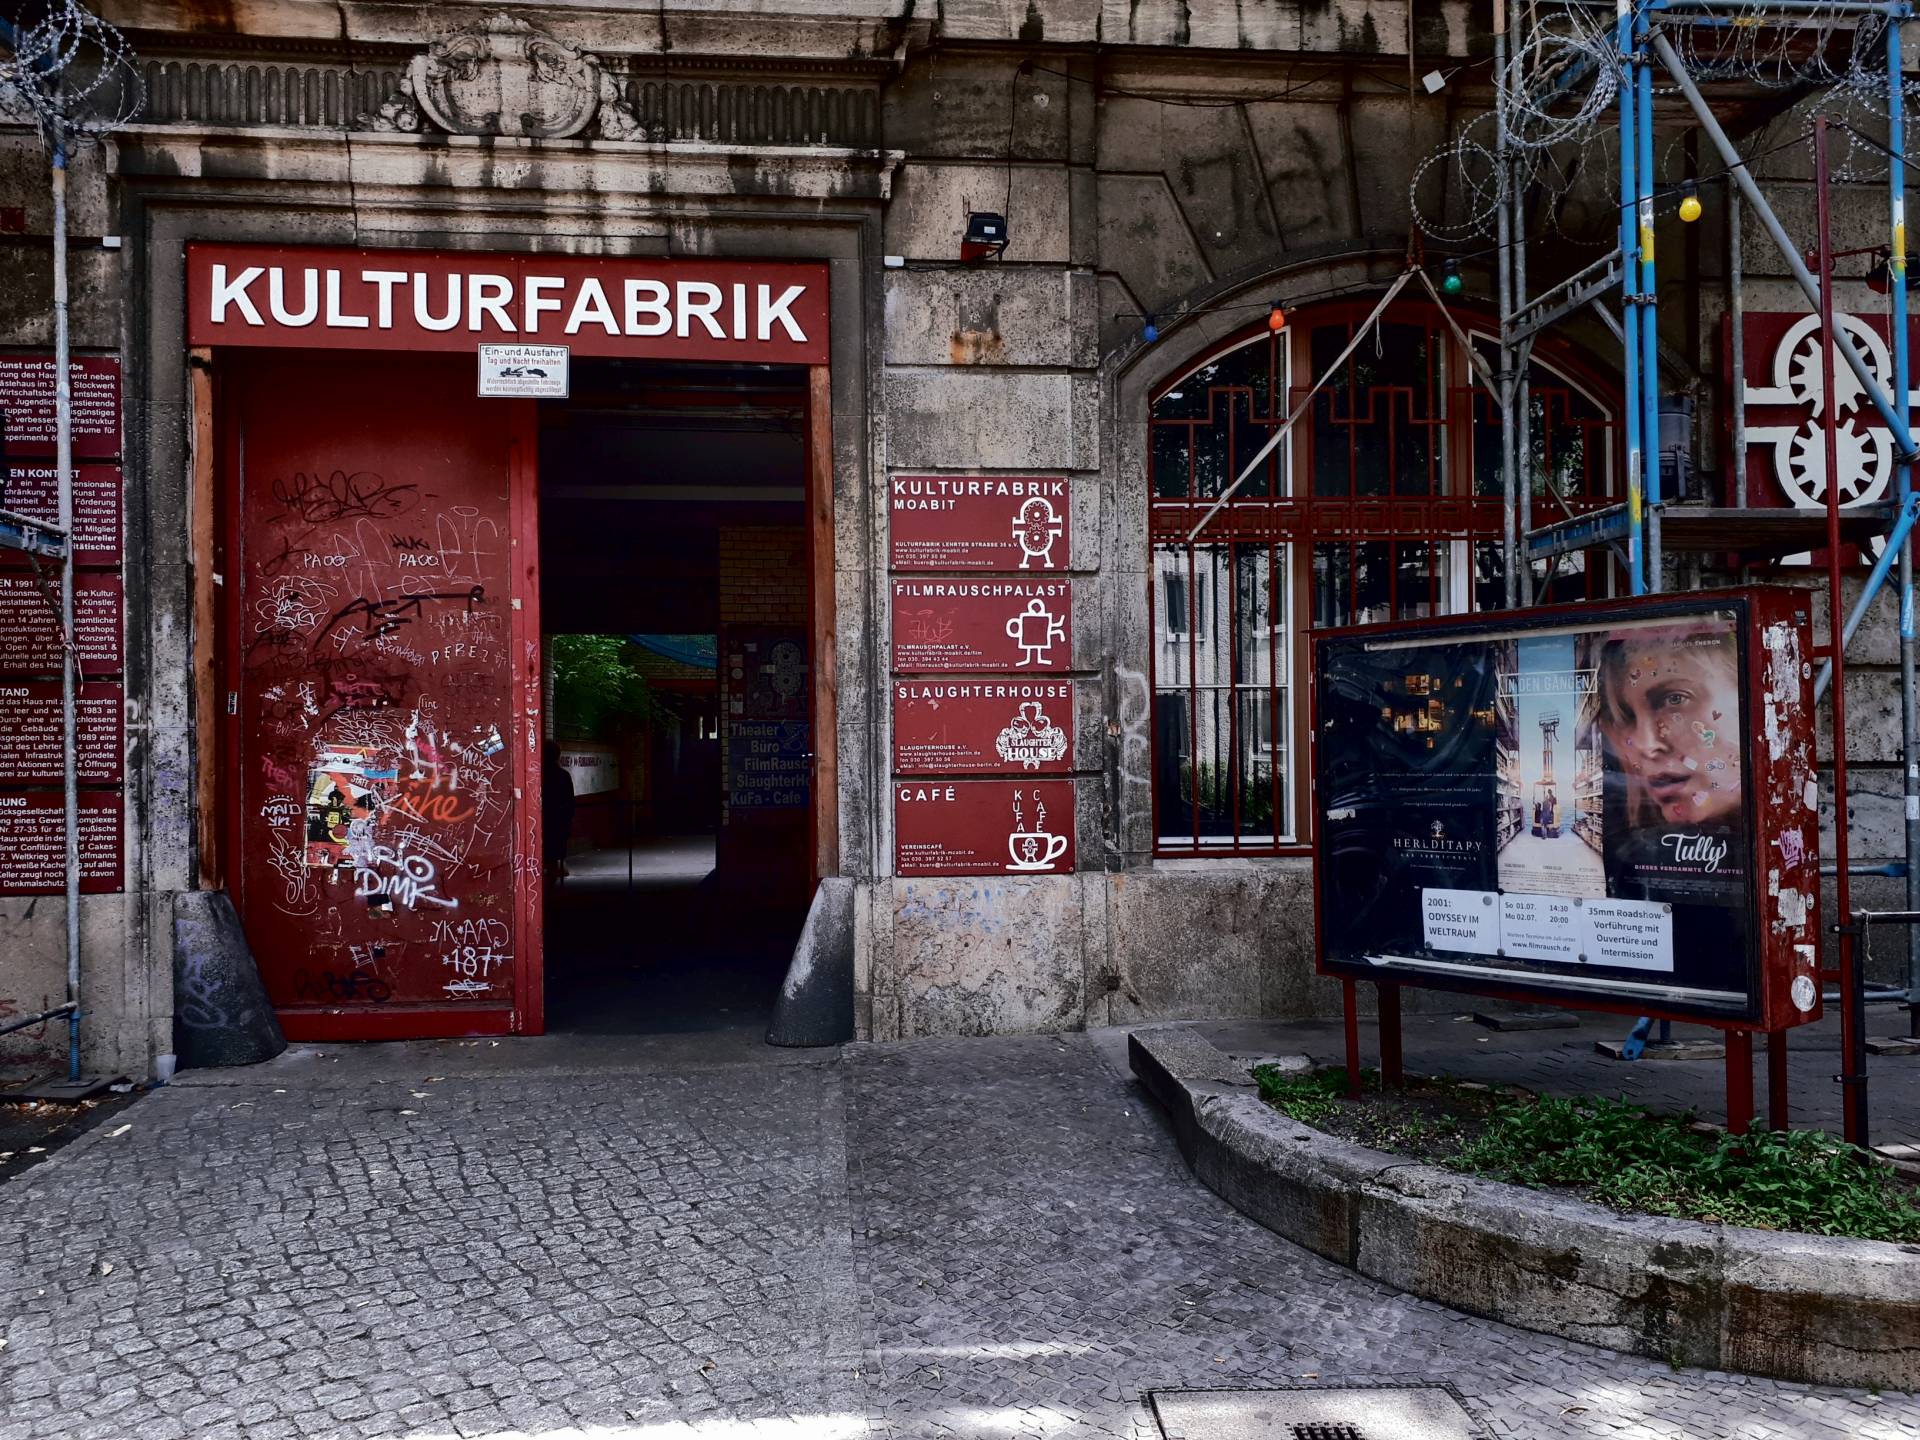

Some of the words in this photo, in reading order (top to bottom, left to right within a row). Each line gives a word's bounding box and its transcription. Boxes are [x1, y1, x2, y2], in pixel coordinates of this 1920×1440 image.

[211, 264, 808, 342] KULTURFABRIK
[894, 481, 1064, 495] KULTURFABRIK
[76, 499, 116, 507] Förderung
[894, 500, 955, 510] MOABIT
[897, 585, 1066, 596] FILMRAUSCHPALAST
[1505, 679, 1515, 692] IN
[1520, 678, 1540, 692] DEN
[899, 687, 1067, 698] SLAUGHTERHOUSE
[730, 723, 778, 736] Theater
[751, 740, 779, 753] Büro
[1010, 739, 1052, 747] SLAUGHTER
[79, 752, 116, 760] gründete.
[1008, 748, 1057, 758] HOUSE
[85, 760, 116, 768] Öffnung
[730, 792, 762, 805] KuFa
[773, 791, 800, 804] Cafe
[901, 786, 955, 801] CAFÉ
[1661, 833, 1727, 873] Tully
[1427, 898, 1451, 908] 2001:
[1505, 902, 1514, 910] So
[1516, 902, 1537, 911] 01.07.
[1550, 905, 1569, 913] 14:30
[1428, 913, 1467, 922] ODYSSEY
[1469, 915, 1479, 924] IM
[1505, 913, 1515, 921] Mo
[1516, 914, 1537, 922] 02.07.
[1550, 916, 1569, 924] 20:00
[1588, 907, 1614, 917] 35mm
[1616, 910, 1665, 920] Roadshow-
[1429, 927, 1476, 938] WELTRAUM
[1594, 921, 1643, 933] Vorführung
[1644, 924, 1659, 933] mit
[1596, 934, 1639, 946] Ouvertüre
[1641, 937, 1658, 947] und
[1512, 942, 1570, 952] www.filmrausch.de
[1601, 948, 1654, 960] Intermission
